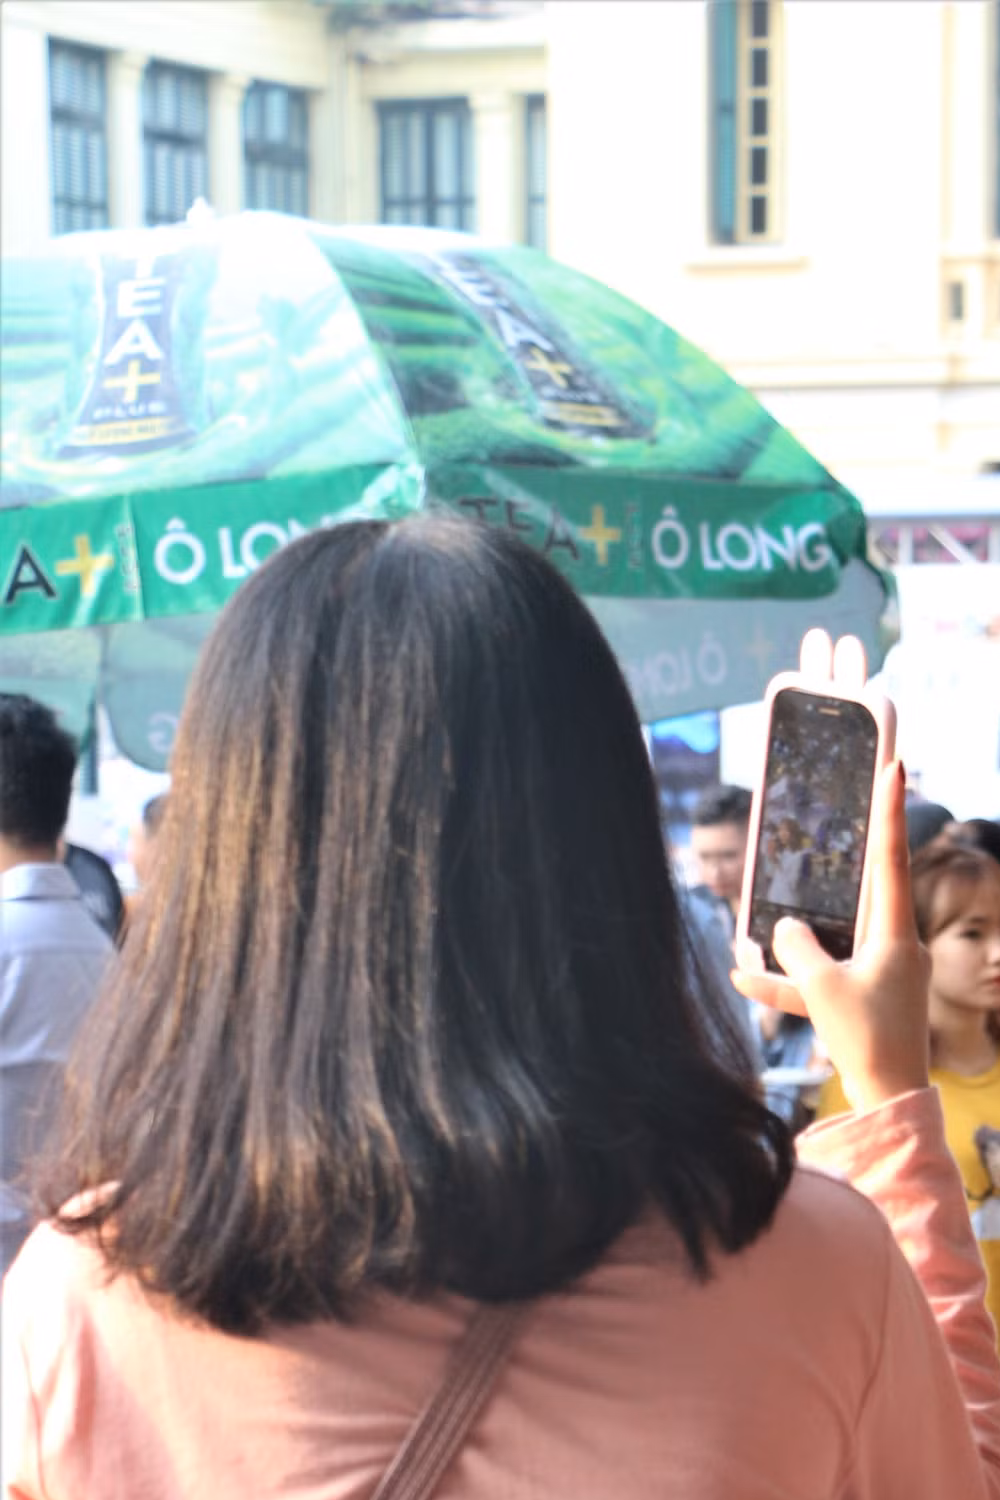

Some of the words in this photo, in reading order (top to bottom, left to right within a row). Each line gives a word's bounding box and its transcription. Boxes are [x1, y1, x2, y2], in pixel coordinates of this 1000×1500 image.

[154, 516, 207, 584] Ô
[651, 505, 690, 569] Ô
[702, 522, 831, 571] LONG
